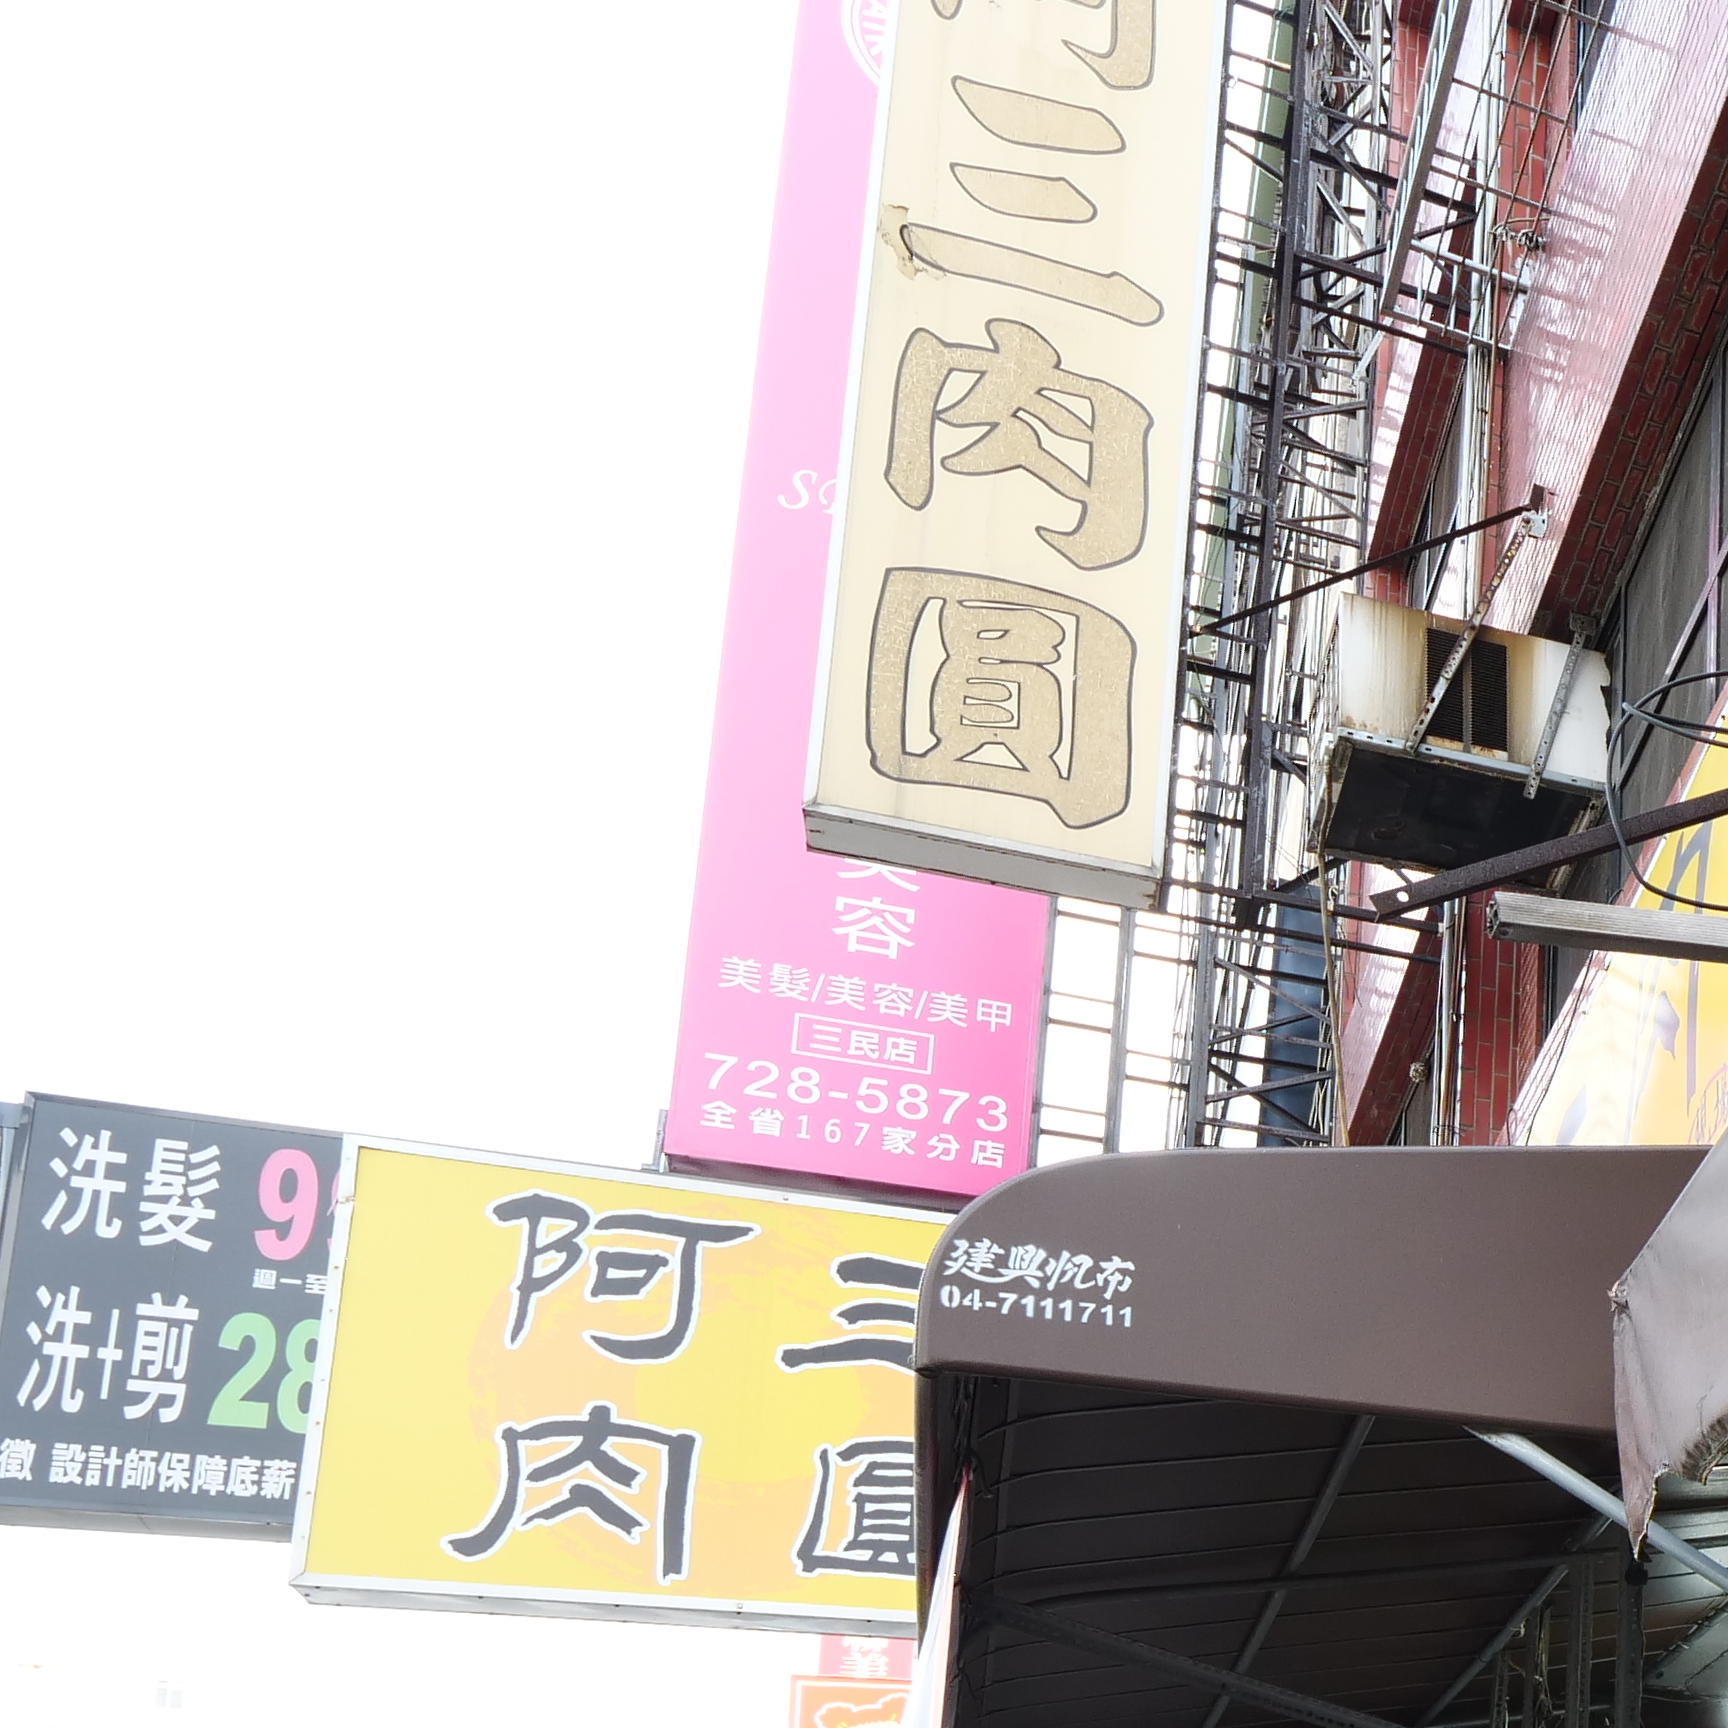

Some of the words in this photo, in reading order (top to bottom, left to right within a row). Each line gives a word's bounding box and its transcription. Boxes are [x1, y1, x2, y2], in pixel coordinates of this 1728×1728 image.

[717, 955, 1013, 1033] 美髮/美容/美甲
[808, 1023, 918, 1064] 三民店
[702, 1052, 1009, 1133] 728-5873
[699, 1099, 1006, 1169] 全省167家分店
[40, 1126, 221, 1253] 洗髮
[486, 1190, 924, 1373] 阿三
[942, 1237, 1136, 1300] 建興帆布
[939, 1284, 1133, 1328] 04-7111711
[0, 1438, 37, 1482] 徵
[48, 1442, 298, 1501] 設計師保障底薪
